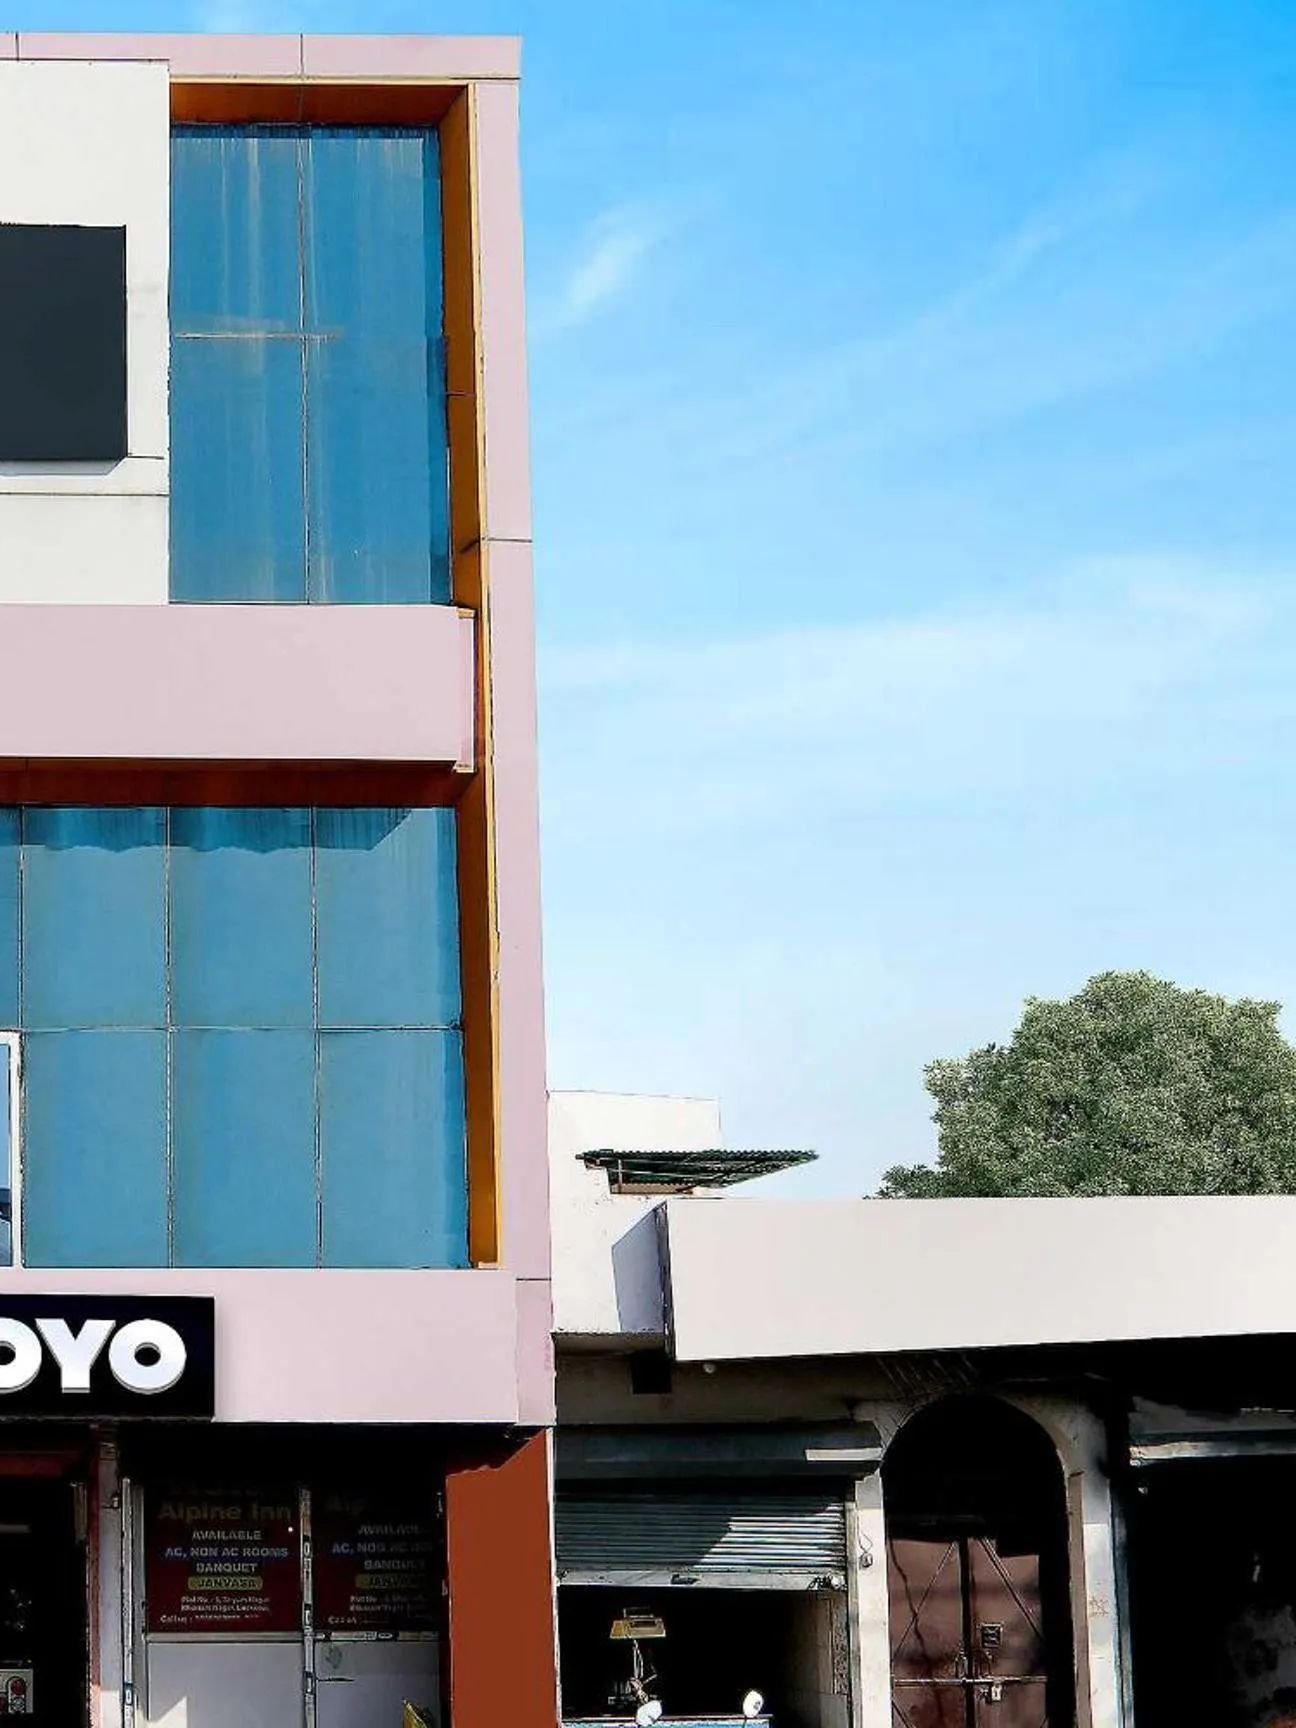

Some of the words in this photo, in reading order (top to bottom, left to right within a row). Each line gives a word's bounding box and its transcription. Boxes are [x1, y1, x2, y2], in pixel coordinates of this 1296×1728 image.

[157, 1500, 242, 1524] Alpine
[250, 1499, 292, 1521] Inn
[191, 1529, 262, 1541] AVAILABLE
[164, 1547, 188, 1558] AC,
[190, 1547, 218, 1557] NON
[221, 1547, 240, 1557] AC
[242, 1547, 289, 1557] ROOMS
[195, 1562, 258, 1573] BANQUET
